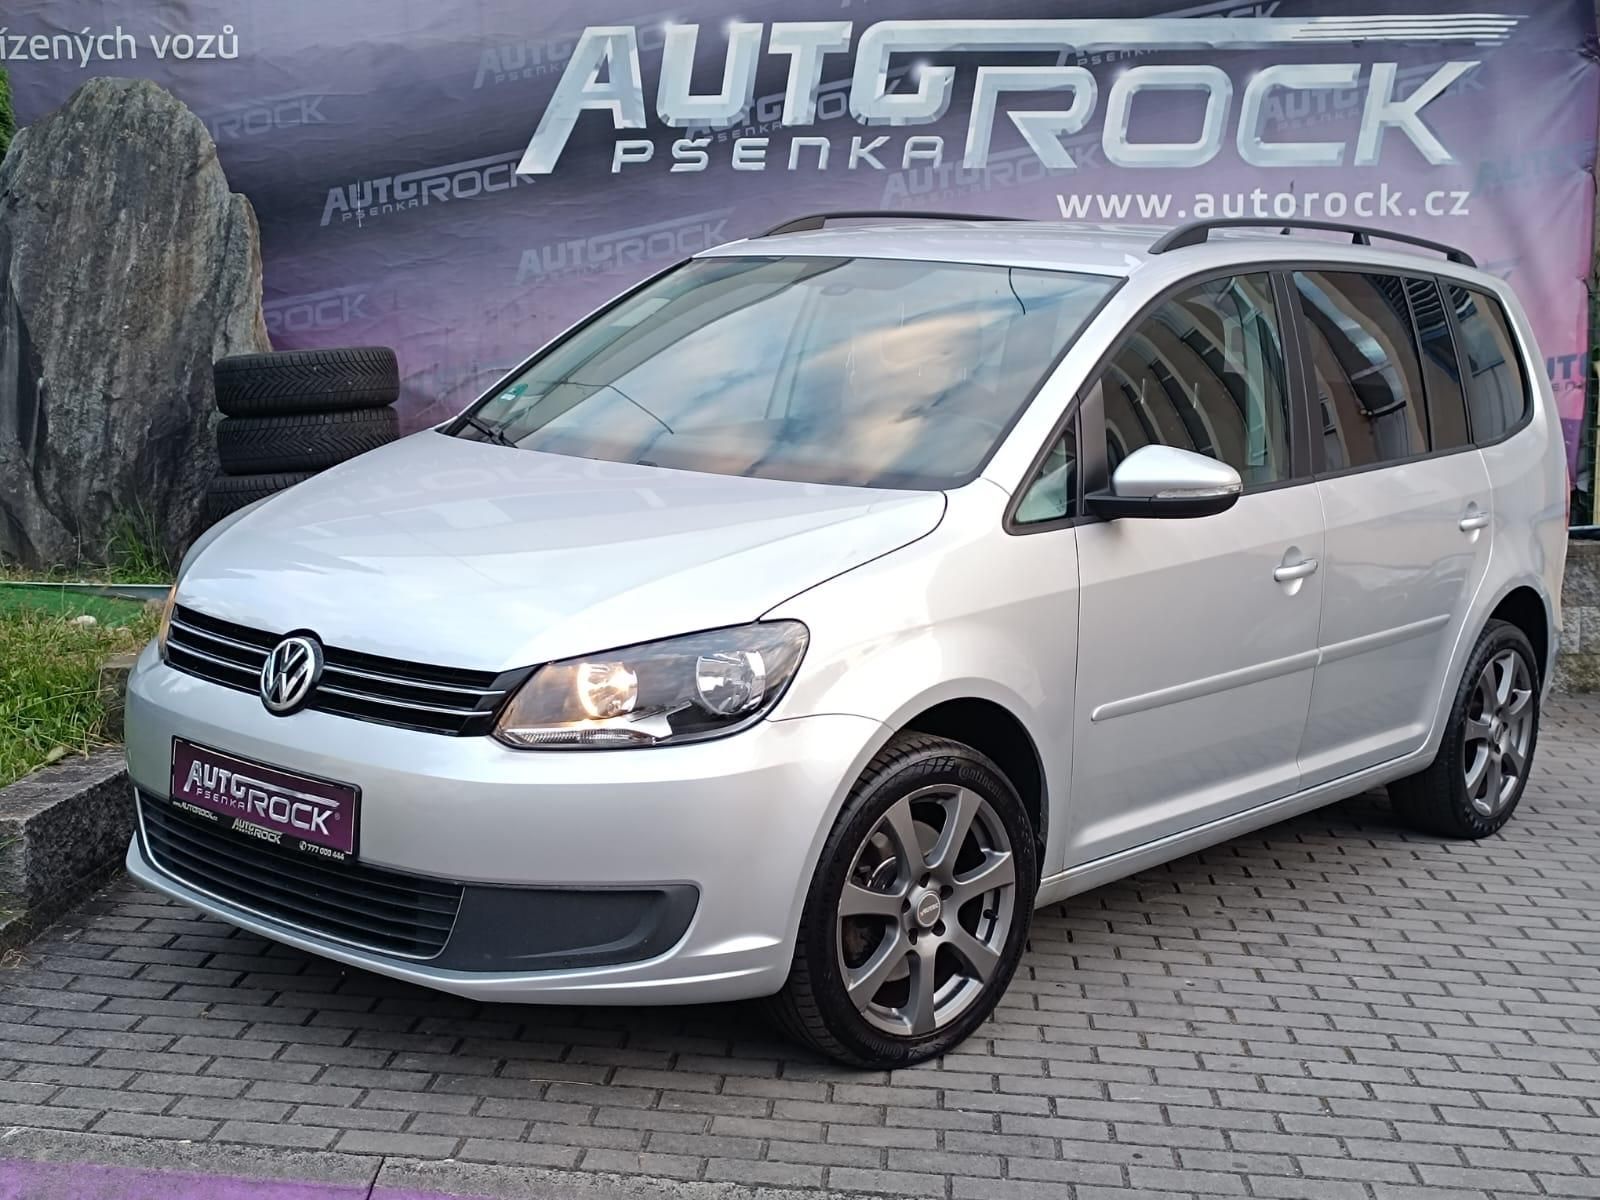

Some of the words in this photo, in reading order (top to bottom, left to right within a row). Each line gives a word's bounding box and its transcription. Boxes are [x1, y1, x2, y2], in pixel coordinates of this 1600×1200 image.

[0, 25, 137, 68] ízených
[150, 25, 239, 60] vozů
[1056, 183, 1471, 219] www.autorock.cz
